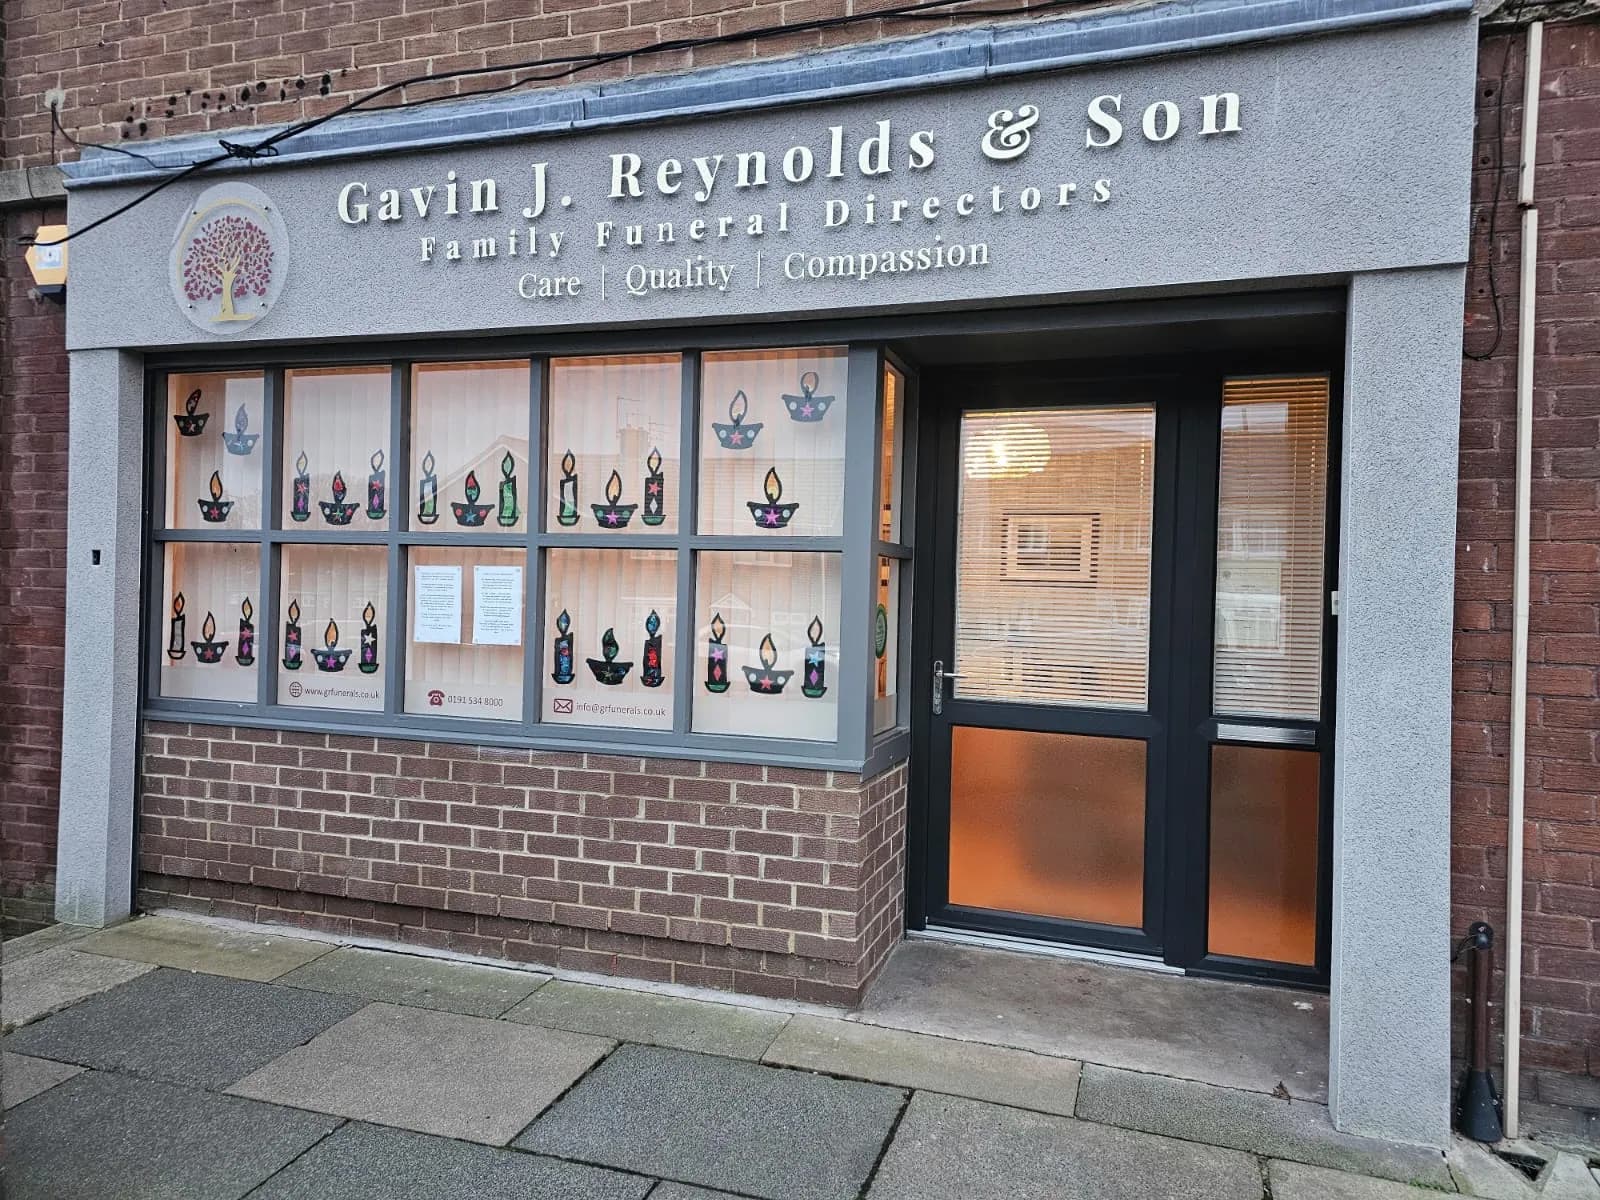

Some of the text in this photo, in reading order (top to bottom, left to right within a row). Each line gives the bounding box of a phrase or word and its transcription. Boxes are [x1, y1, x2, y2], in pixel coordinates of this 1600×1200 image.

[336, 89, 1243, 225] Gavin J. Reynolds & Son
[420, 178, 1112, 263] Family Funeral Directors
[518, 235, 991, 299] Care Quality Compassion
[304, 687, 380, 699] www.grfunerals.co.uk
[447, 695, 504, 707] 0191 534 8000
[576, 702, 667, 716] info@grfunerals.co.uk
